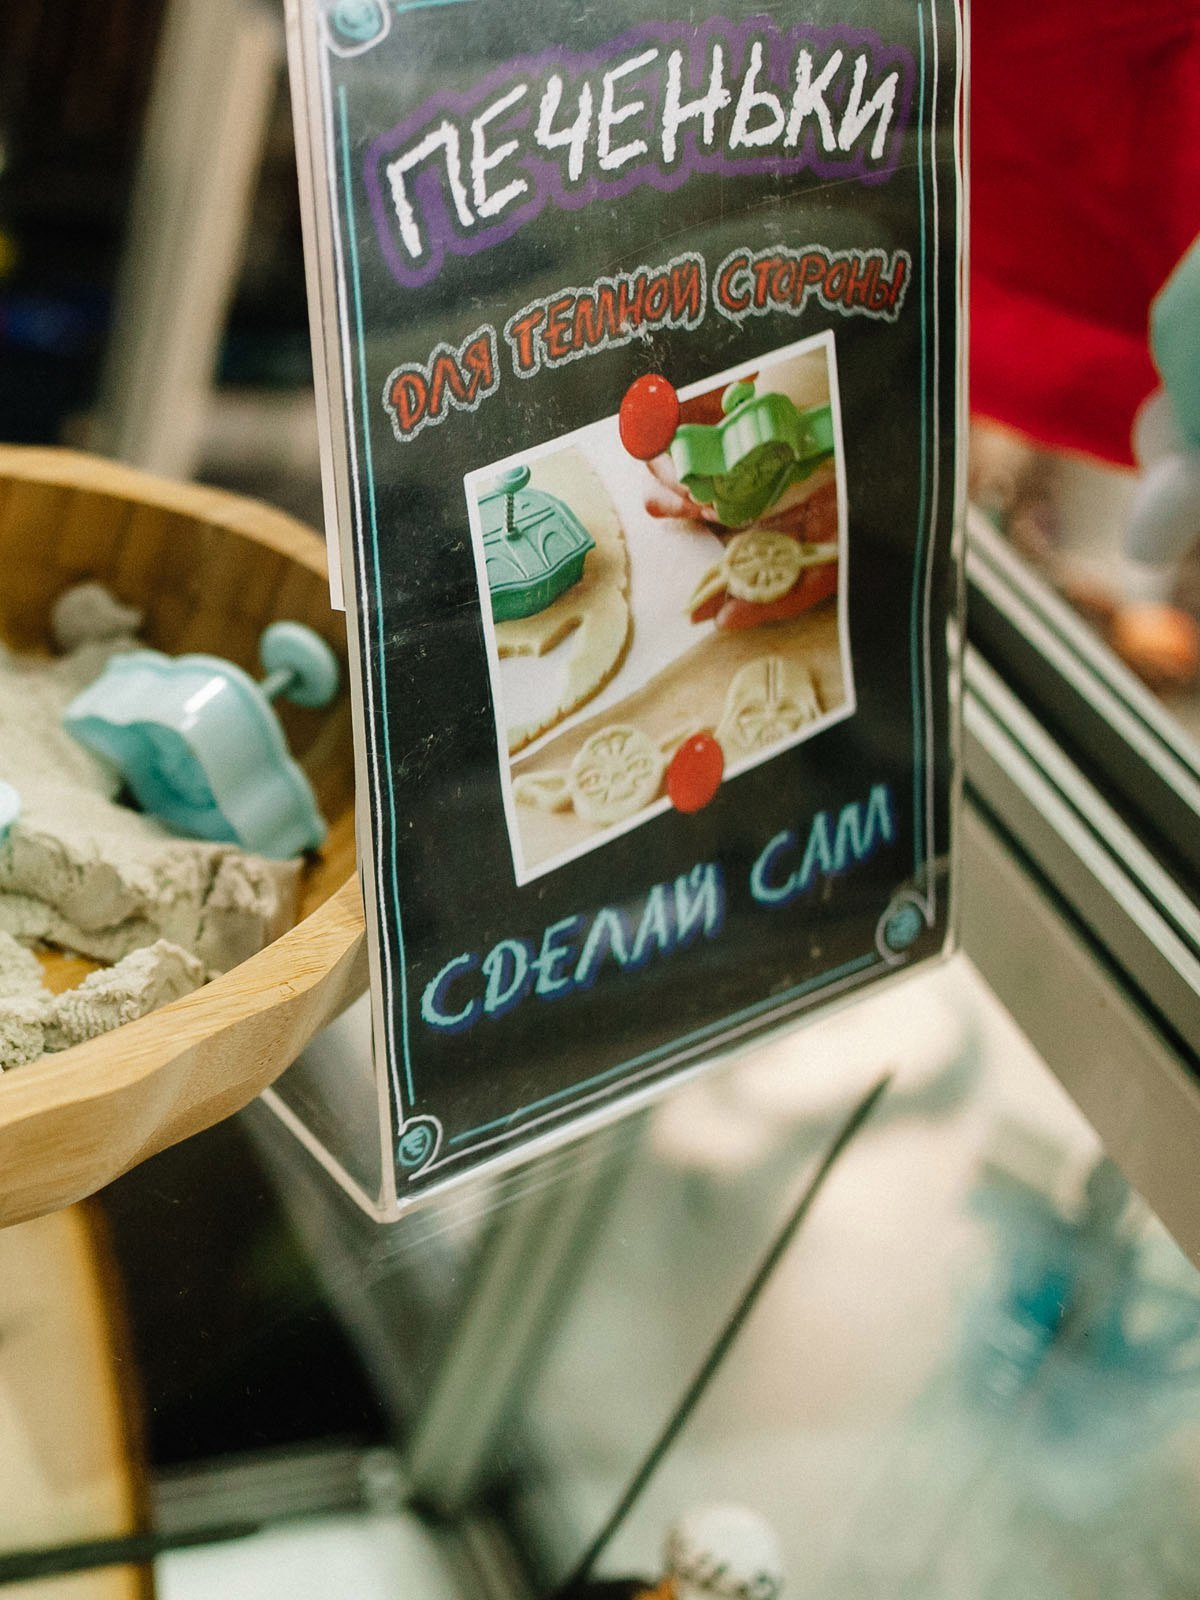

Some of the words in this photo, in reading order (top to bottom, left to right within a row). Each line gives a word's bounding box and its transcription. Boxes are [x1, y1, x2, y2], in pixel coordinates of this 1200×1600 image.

[386, 42, 898, 257] ПЕЧЕНЬКИ
[386, 328, 499, 439] ДЛЯ
[506, 255, 703, 374] ТЕМНОЙ
[715, 249, 908, 320] СТОРОНЫ
[420, 863, 722, 1027] СДЕЛАЙ
[750, 784, 893, 901] САМ
